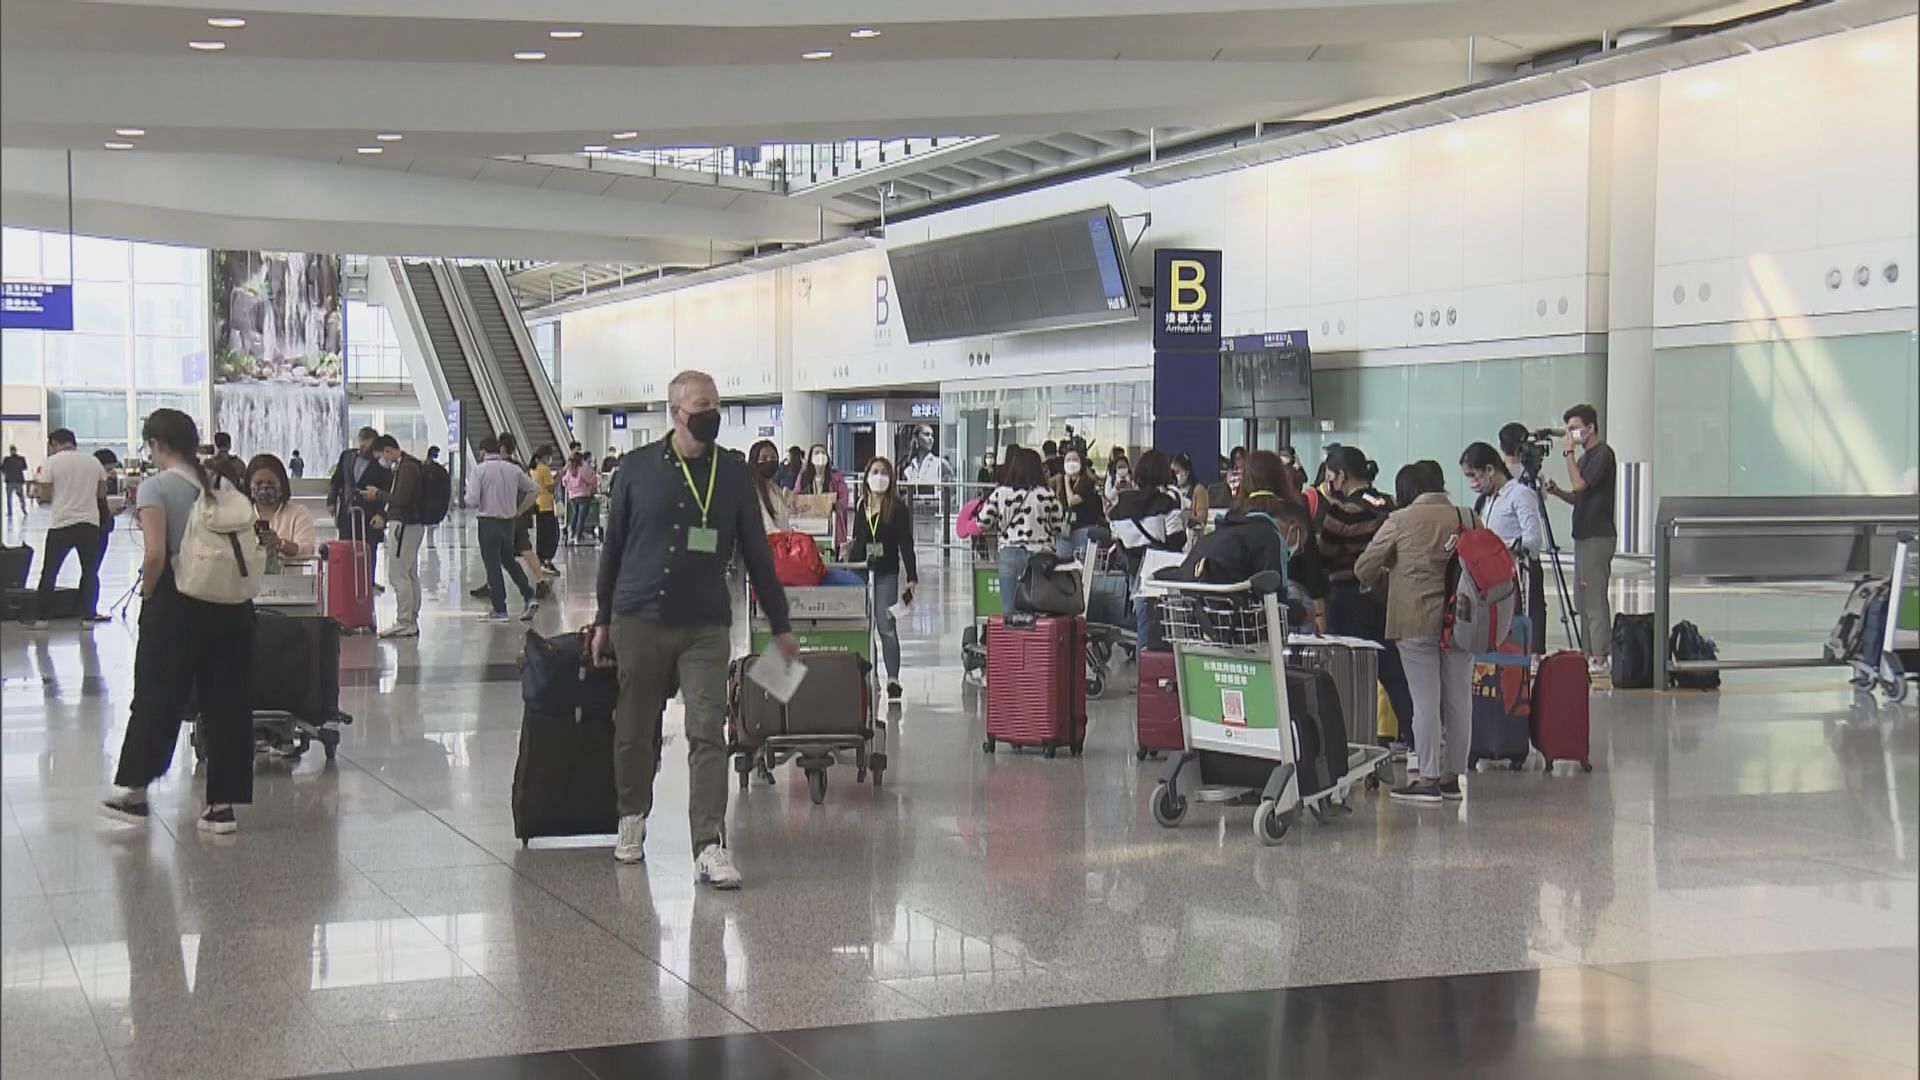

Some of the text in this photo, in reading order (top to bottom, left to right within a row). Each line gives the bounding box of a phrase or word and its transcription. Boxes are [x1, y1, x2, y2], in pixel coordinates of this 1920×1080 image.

[1170, 260, 1207, 311] B
[876, 276, 889, 325] B
[1165, 312, 1212, 324] 接機大堂
[1165, 323, 1212, 333] Arrivals Hall
[1286, 333, 1293, 347] A
